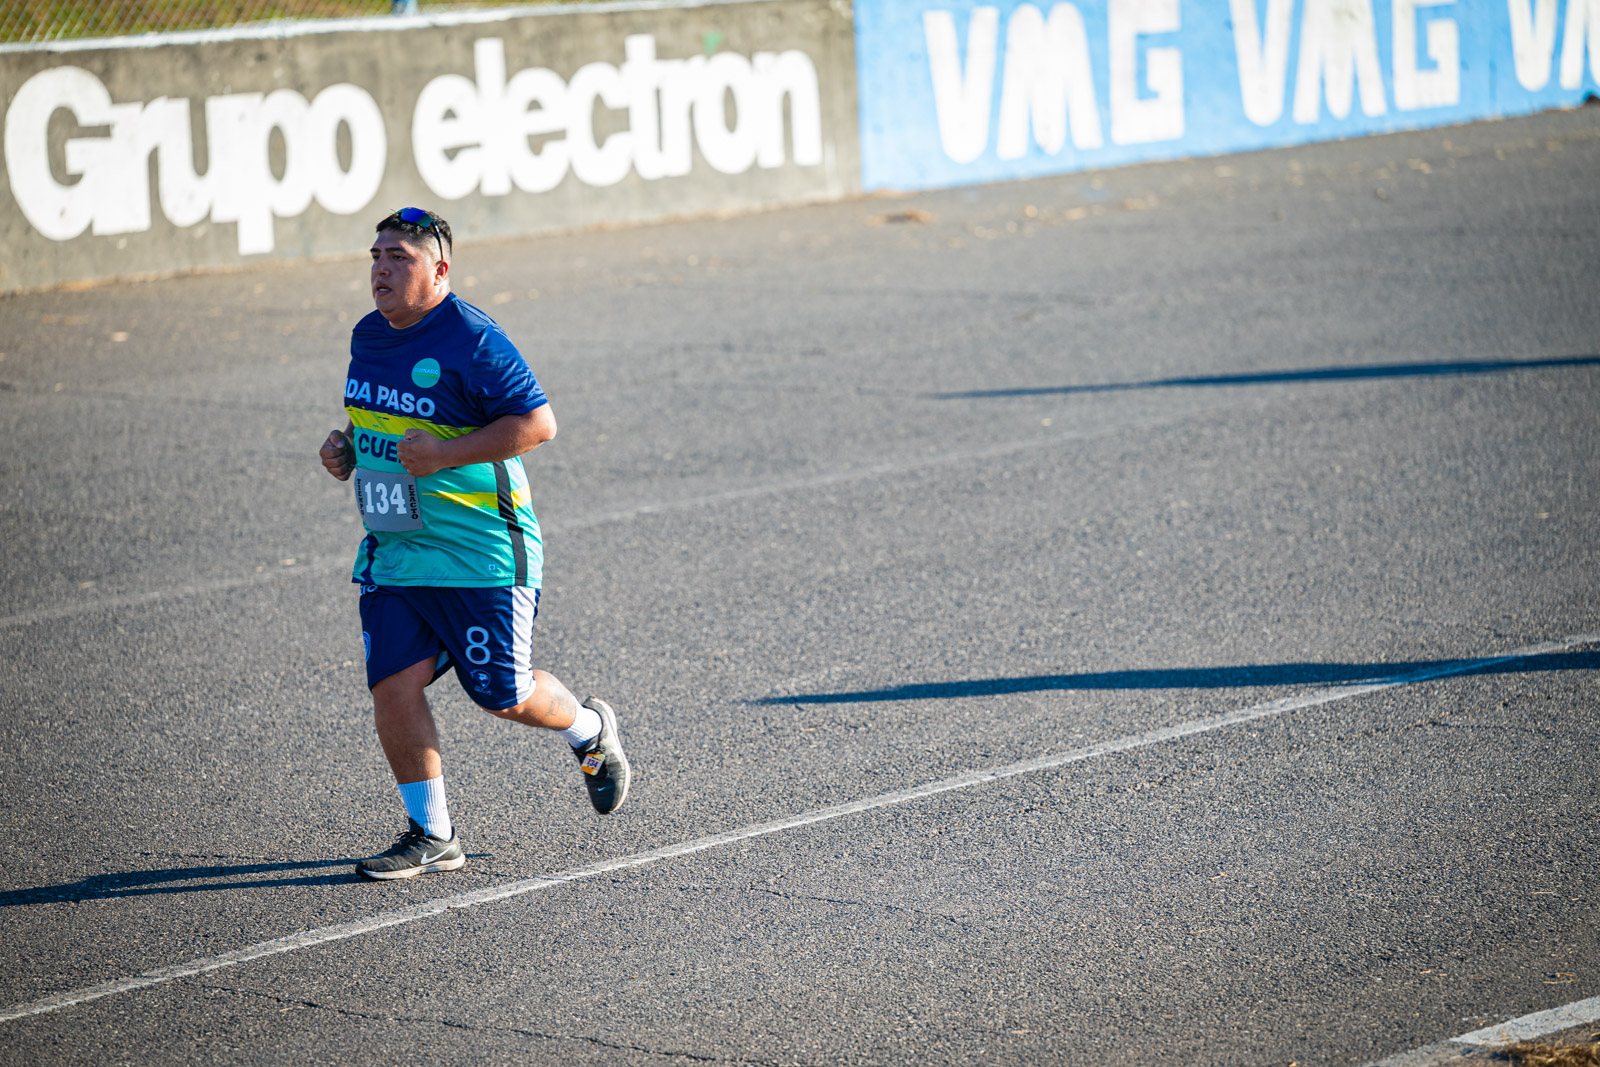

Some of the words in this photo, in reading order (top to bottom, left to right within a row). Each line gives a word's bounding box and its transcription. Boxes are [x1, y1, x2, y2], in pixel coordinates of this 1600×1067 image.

[923, 0, 1185, 163] VMG
[1230, 0, 1460, 127] VMG
[4, 65, 387, 256] Grupo
[411, 34, 822, 200] electron
[344, 377, 371, 403] DA
[376, 384, 436, 417] PASO
[358, 433, 402, 464] CUE
[364, 481, 407, 515] 134
[408, 484, 419, 520] EXACTO
[465, 626, 491, 665] 8
